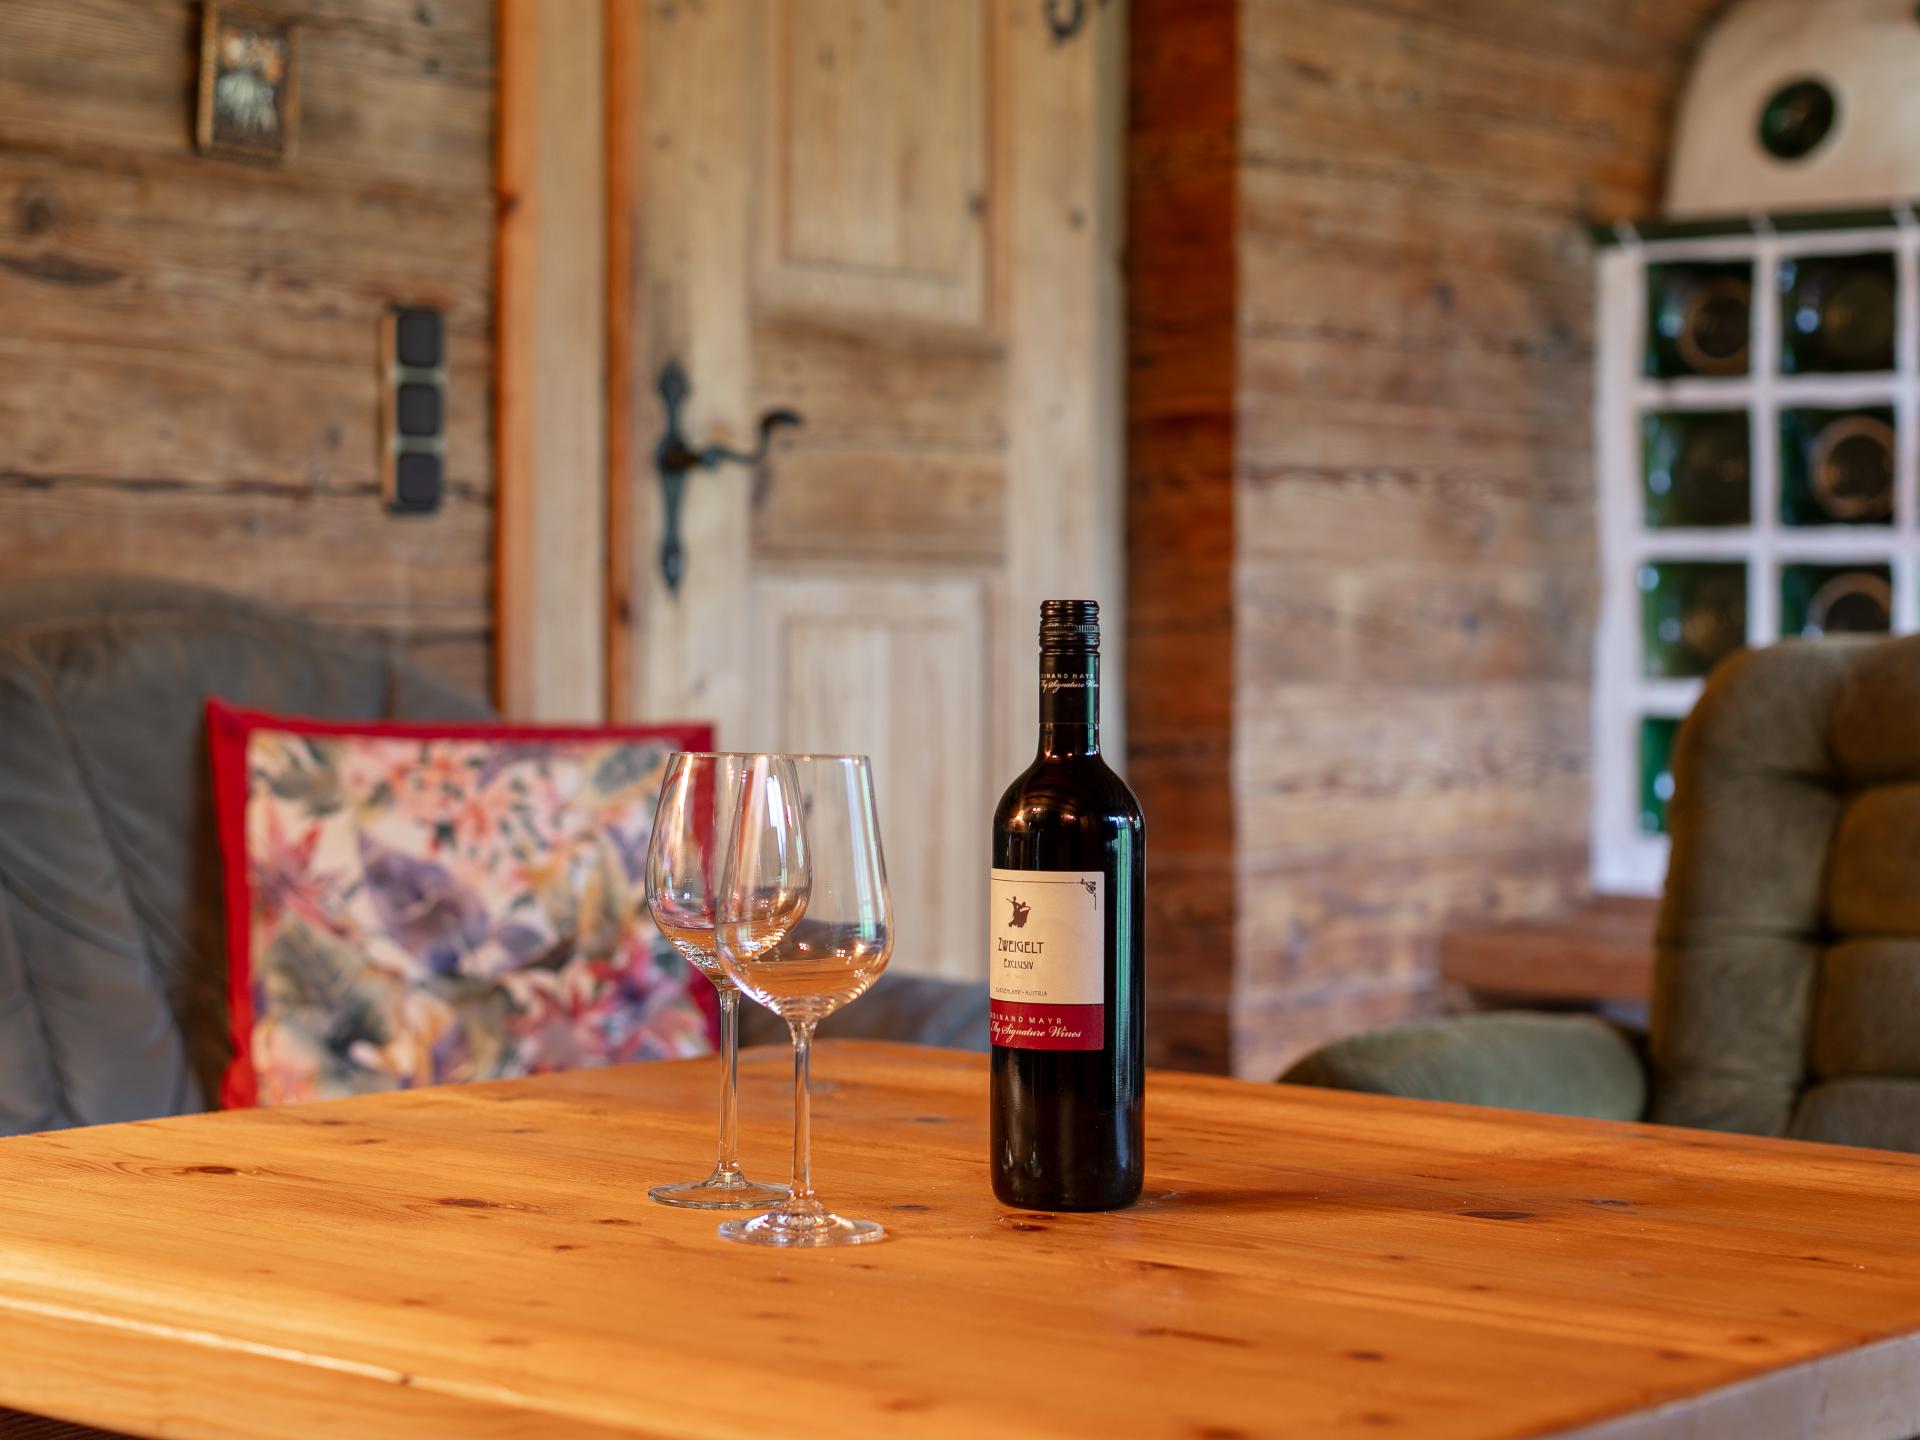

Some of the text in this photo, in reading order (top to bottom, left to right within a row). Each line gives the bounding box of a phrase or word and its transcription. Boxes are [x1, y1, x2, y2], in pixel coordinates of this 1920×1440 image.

[1048, 679, 1085, 694] Signature
[1029, 1016, 1063, 1025] MAYR
[1001, 1023, 1046, 1043] Signature
[1048, 1025, 1082, 1038] Wines
